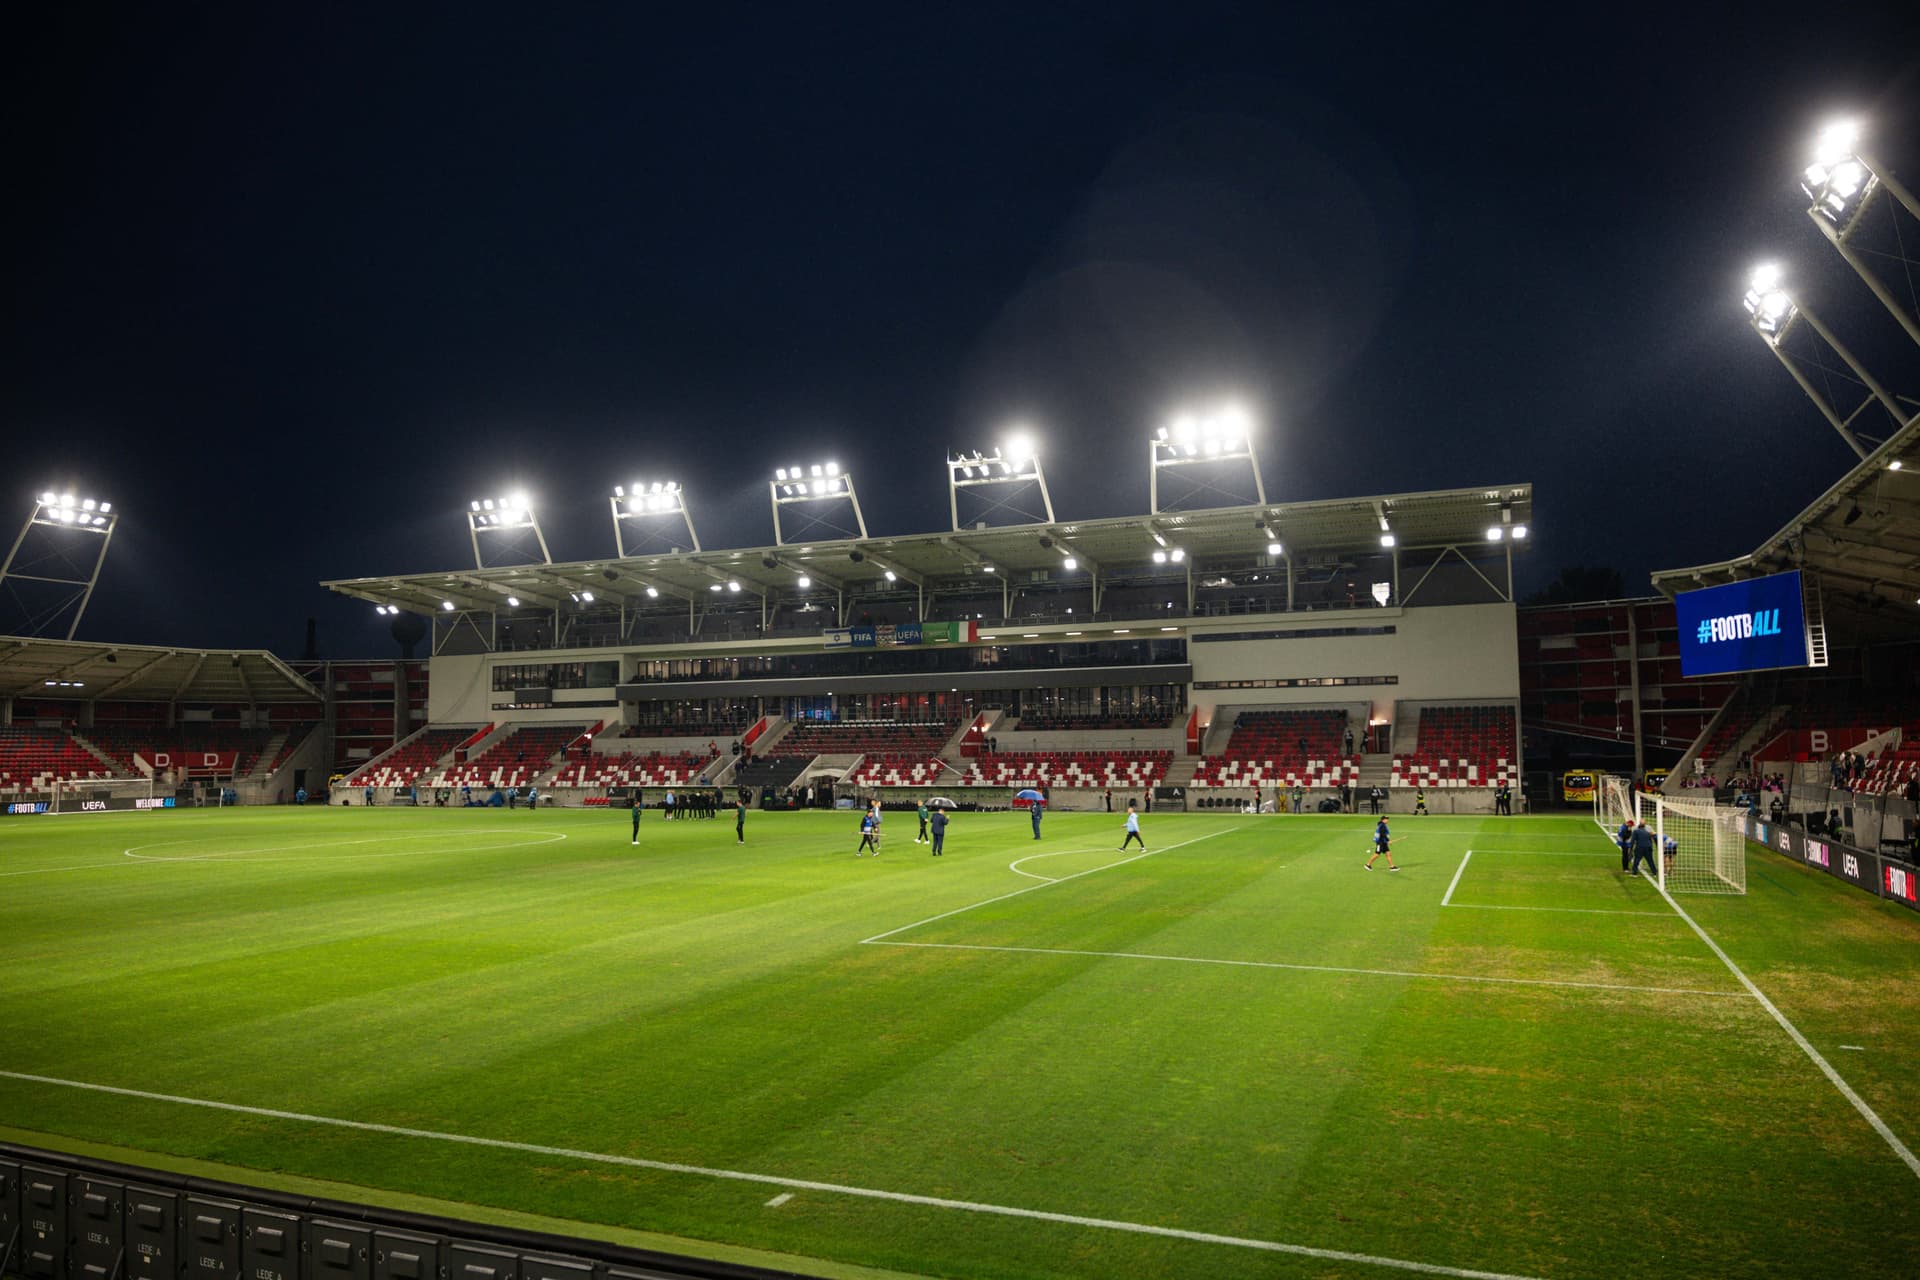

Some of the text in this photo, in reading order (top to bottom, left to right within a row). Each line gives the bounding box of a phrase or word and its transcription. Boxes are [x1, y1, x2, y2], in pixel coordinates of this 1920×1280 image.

[1697, 608, 1781, 644] #FOOTBALL
[853, 632, 872, 641] FIFA
[897, 631, 920, 640] UEFA
[1810, 730, 1829, 752] B
[155, 753, 170, 767] D
[203, 753, 219, 766] D
[7, 802, 48, 814] #FOOTBALL
[82, 800, 106, 810] UEFA
[1842, 852, 1860, 879] UEFA
